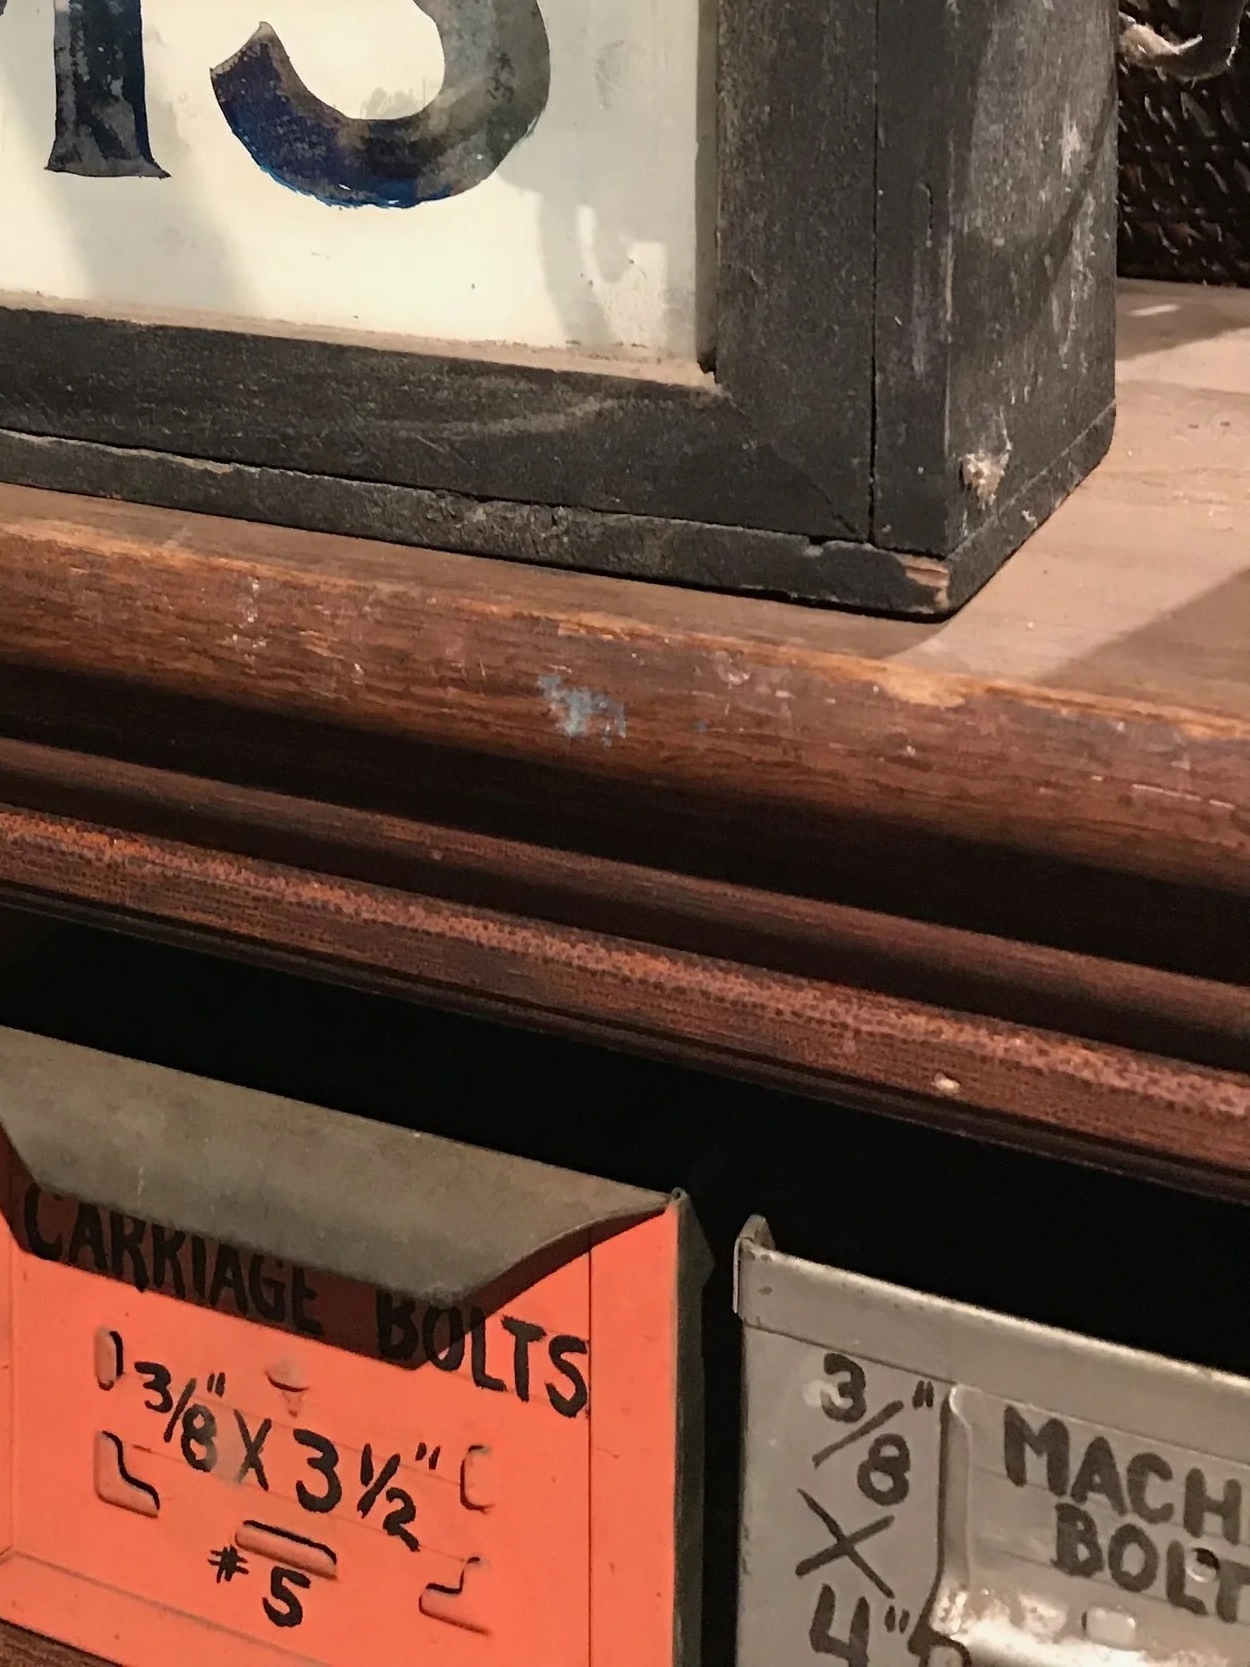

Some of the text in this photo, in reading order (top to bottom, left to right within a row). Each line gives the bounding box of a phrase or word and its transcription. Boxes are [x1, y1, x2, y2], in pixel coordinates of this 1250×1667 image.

[23, 1182, 589, 1418] CARRIAGE BOLTS
[1003, 1404, 1243, 1546] MACH
